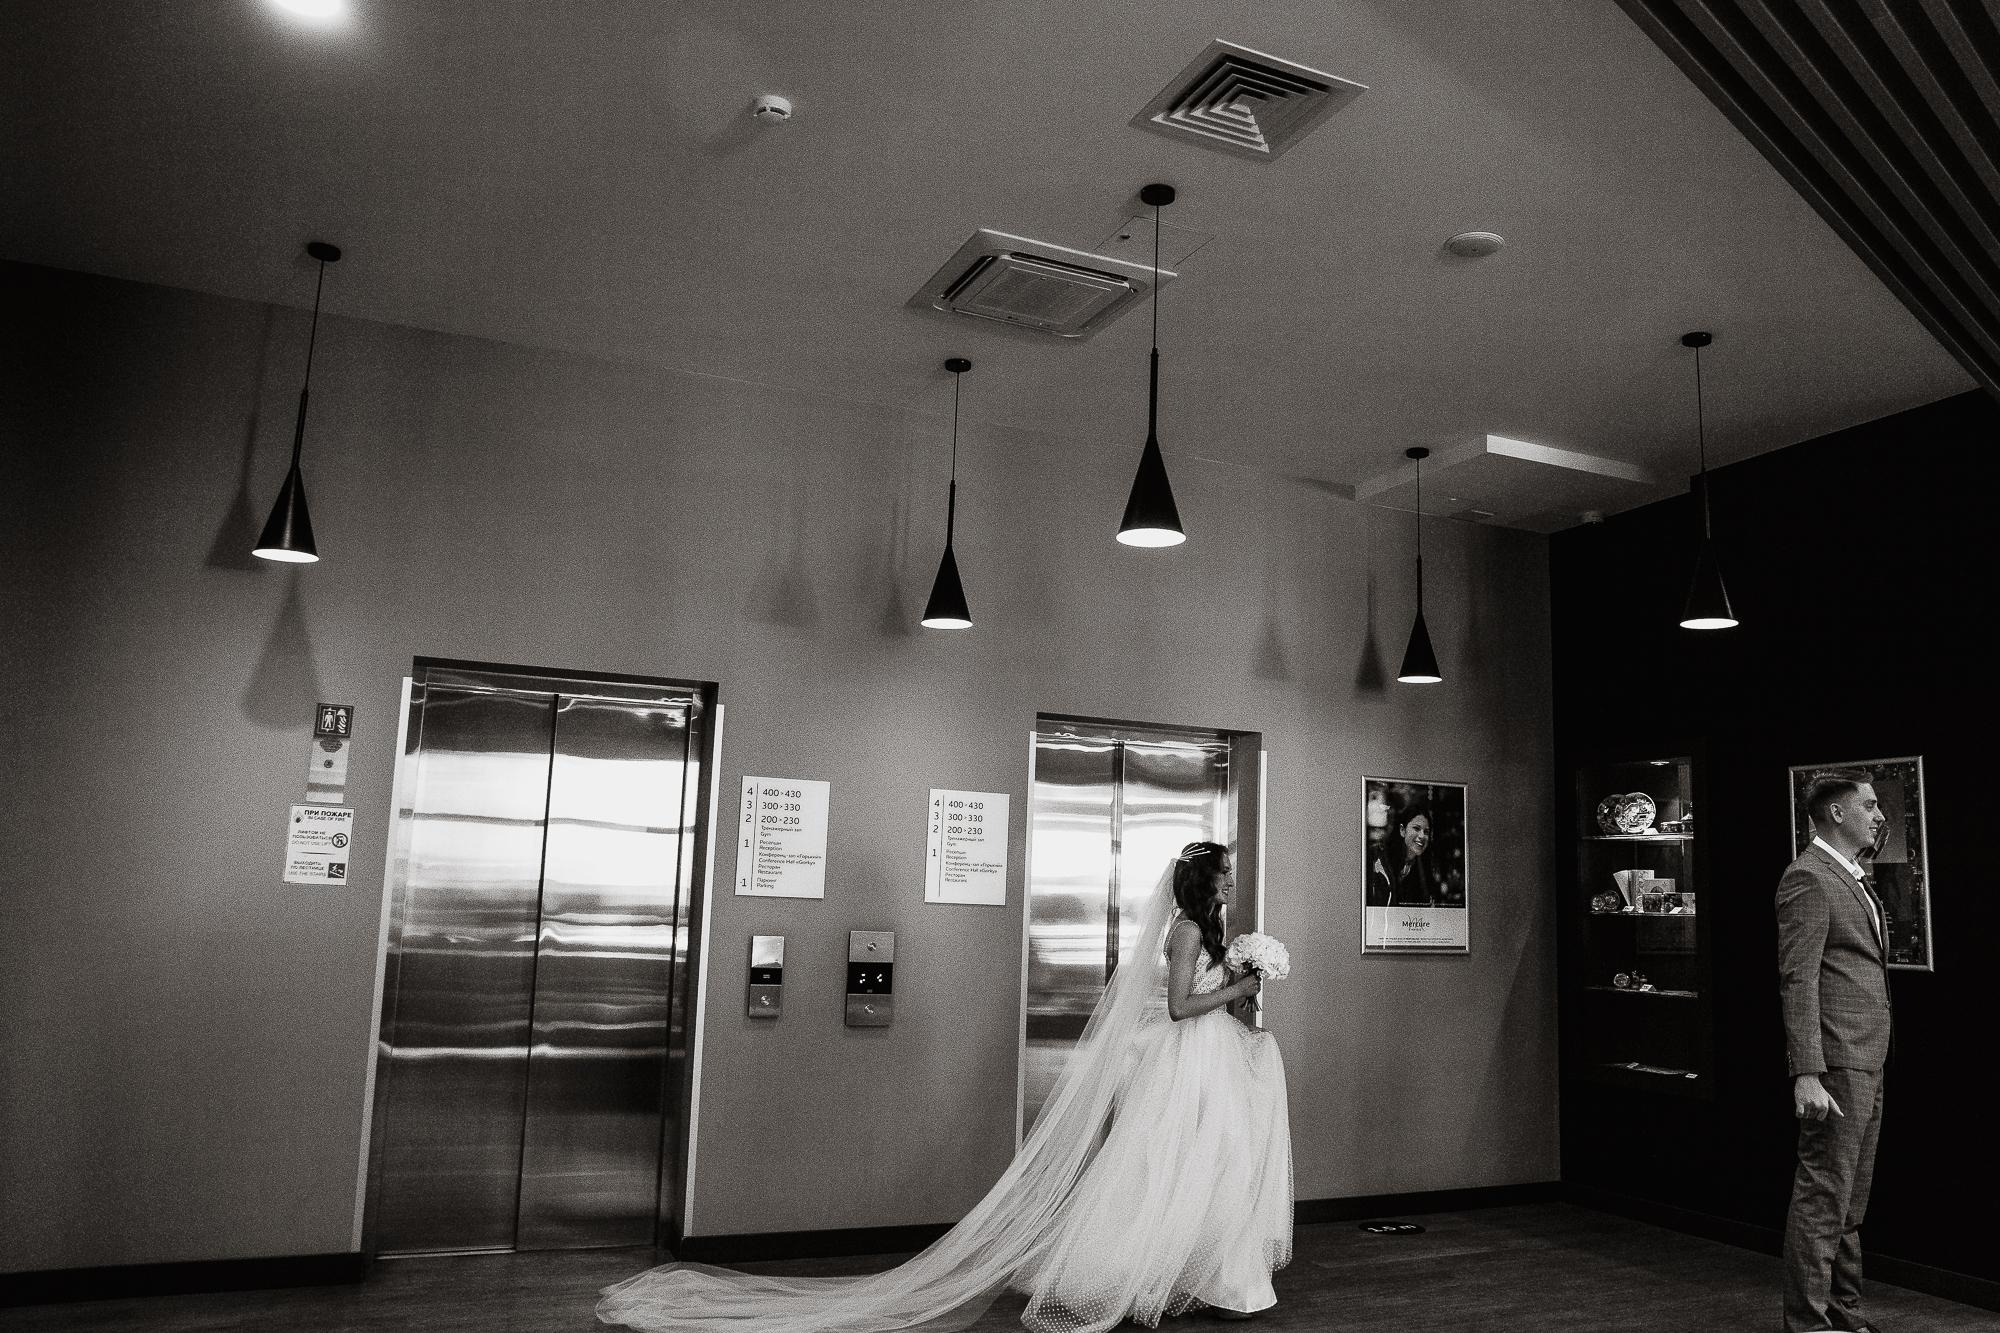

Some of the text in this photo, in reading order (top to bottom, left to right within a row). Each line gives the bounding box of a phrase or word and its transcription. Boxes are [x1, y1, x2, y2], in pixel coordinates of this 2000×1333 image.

[747, 787, 802, 798] 4 400 430
[746, 800, 801, 811] 3 300 330
[745, 814, 800, 824] 2 200 230
[934, 812, 939, 820] 3
[933, 824, 939, 833] 2
[744, 839, 750, 848] 1
